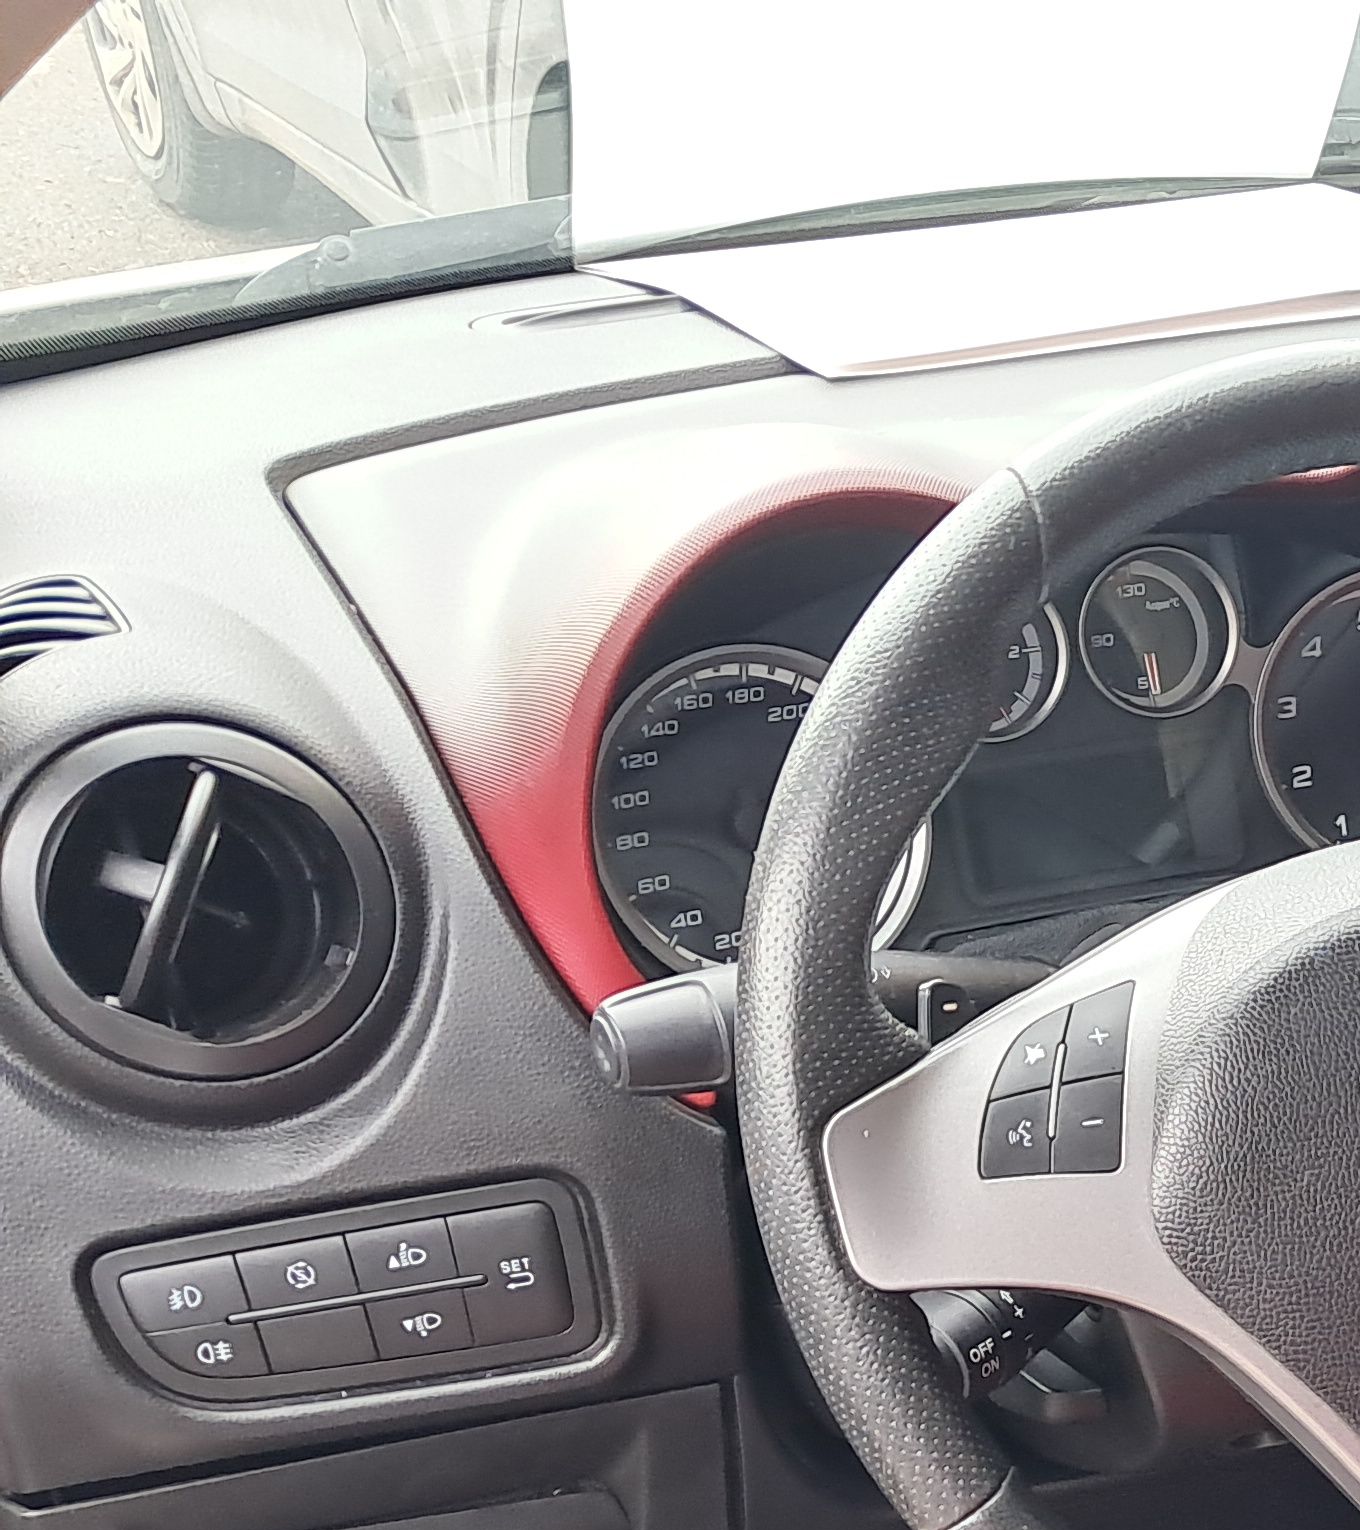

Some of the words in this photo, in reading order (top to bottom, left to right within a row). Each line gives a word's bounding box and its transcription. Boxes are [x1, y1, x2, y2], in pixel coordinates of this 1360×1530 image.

[1116, 582, 1146, 599] 130
[1301, 635, 1323, 659] 4
[673, 692, 714, 712] 160
[724, 686, 766, 704] 180
[1276, 696, 1297, 719] 3
[640, 720, 680, 738] 140
[619, 751, 659, 770] 120
[1291, 765, 1313, 789] 2
[610, 790, 650, 810] 100
[1333, 814, 1348, 837] 1
[615, 831, 650, 851] 80
[636, 874, 671, 894] 60
[670, 909, 703, 929] 40
[499, 1257, 531, 1274] SET
[969, 1337, 995, 1363] OFF
[981, 1355, 1000, 1378] ON
